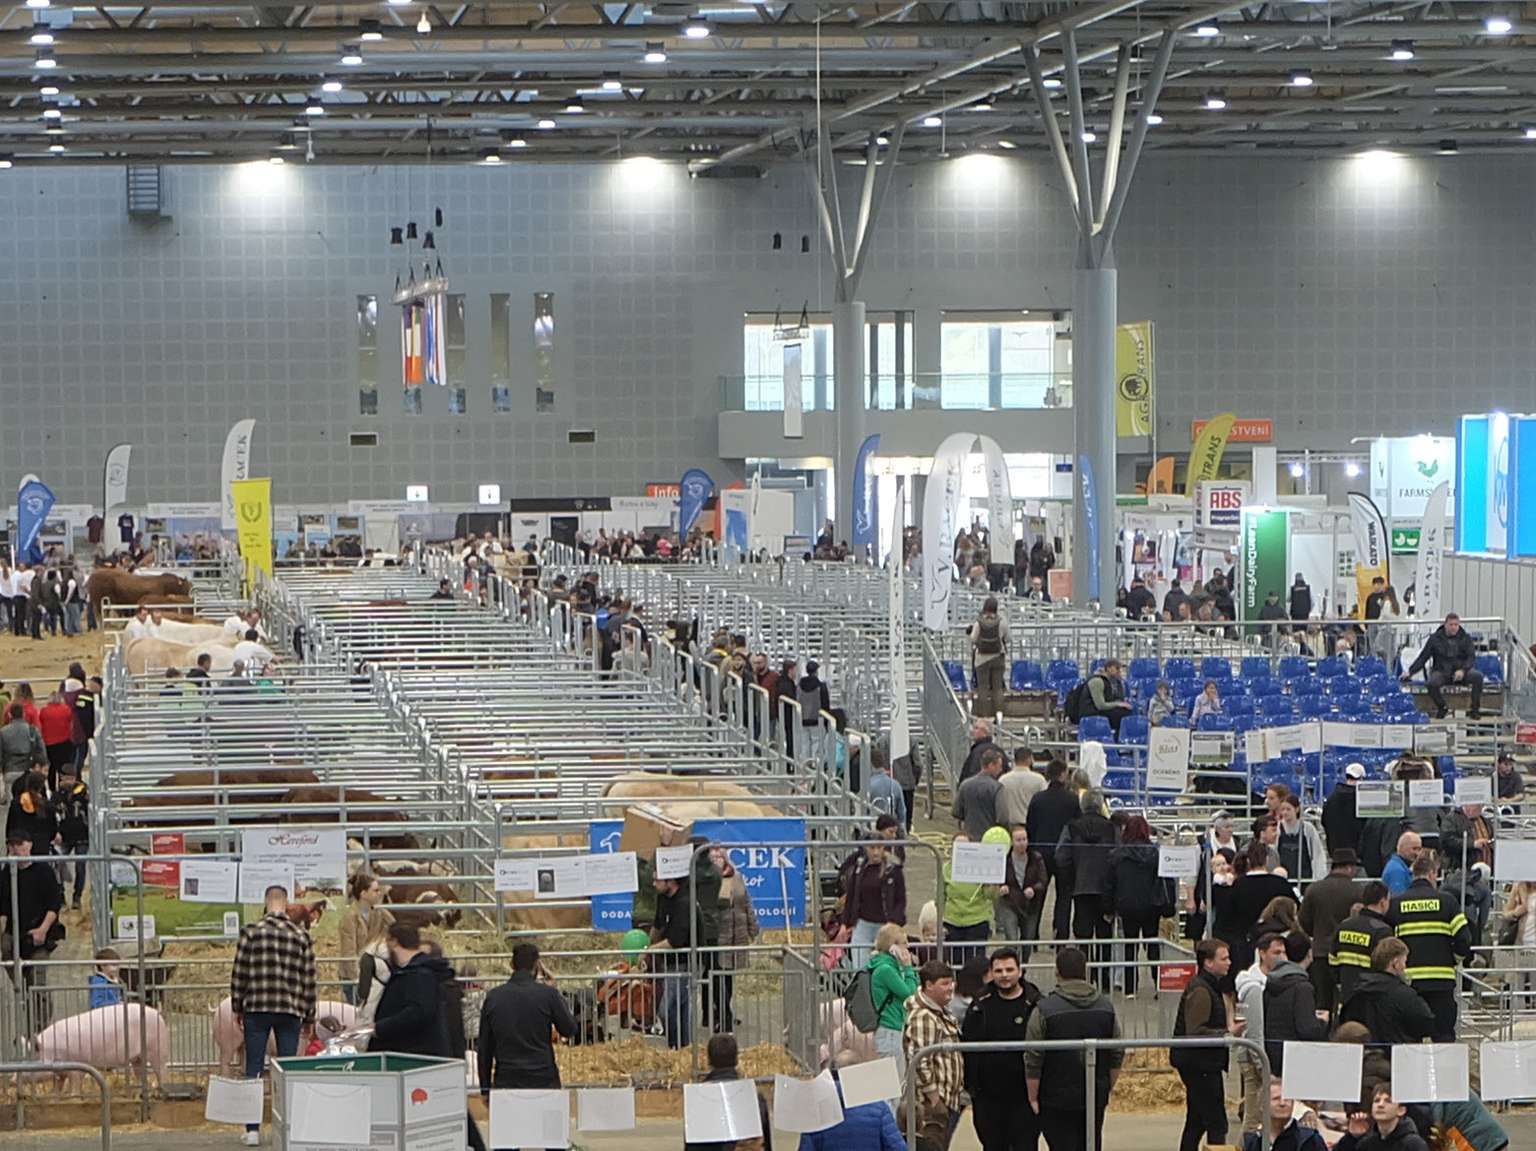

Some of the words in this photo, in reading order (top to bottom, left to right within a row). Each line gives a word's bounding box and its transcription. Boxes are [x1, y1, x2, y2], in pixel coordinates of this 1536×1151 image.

[654, 485, 679, 498] Info
[1210, 491, 1242, 508] ABS
[268, 832, 319, 848] Hereford
[727, 847, 796, 869] CEK
